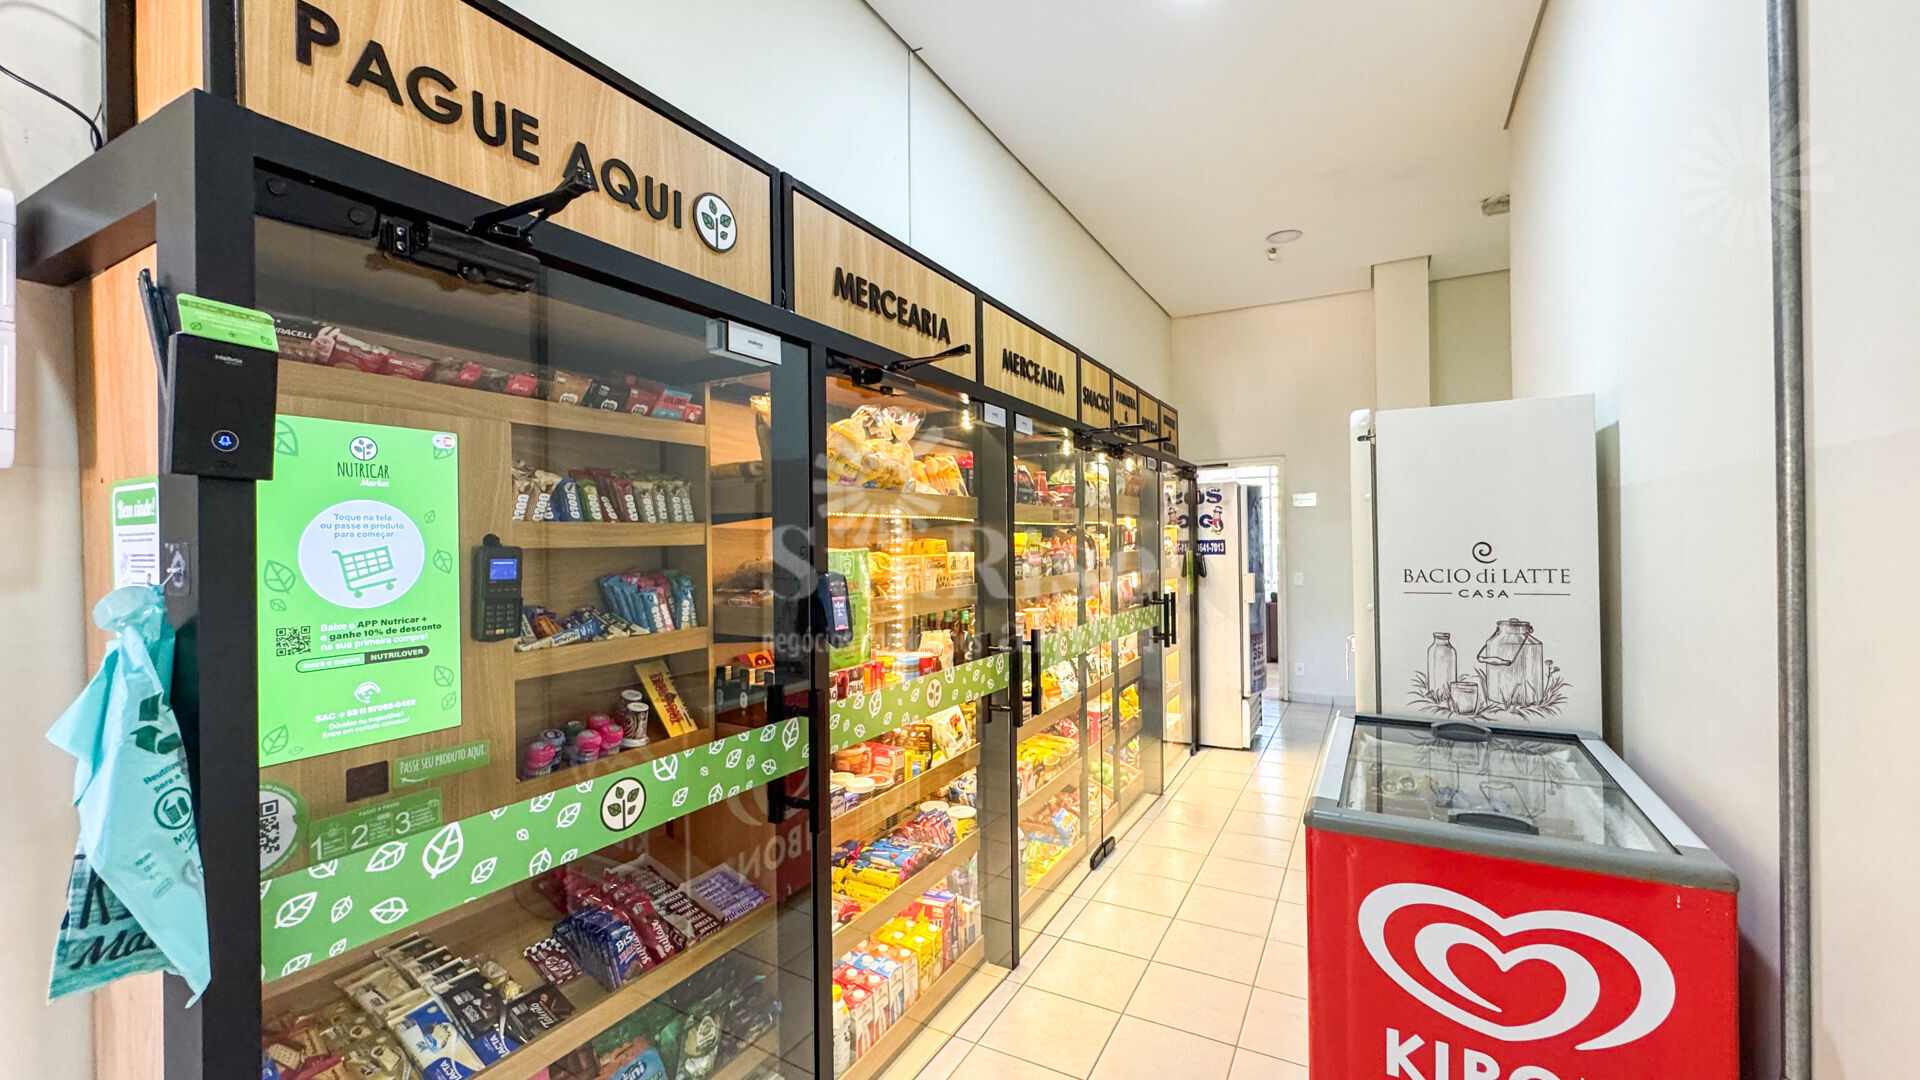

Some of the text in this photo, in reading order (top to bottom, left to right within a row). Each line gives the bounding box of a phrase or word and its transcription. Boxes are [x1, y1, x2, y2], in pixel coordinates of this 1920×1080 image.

[295, 3, 682, 229] PAGUE AQUI
[833, 267, 951, 345] MERCEARIA
[1001, 348, 1065, 396] MERCEARIA
[1083, 386, 1109, 414] SNACKS
[337, 462, 390, 479] NUTRICAR
[360, 478, 390, 487] Market
[333, 513, 361, 521] Toque
[334, 523, 361, 531] passe
[371, 522, 404, 531] produto
[1404, 568, 1571, 584] BACIO di LATTE
[1458, 589, 1509, 598] CASA
[320, 623, 347, 633] Baixe
[357, 620, 379, 629] APP
[380, 617, 419, 627] Nutricar
[329, 630, 361, 642] ganhe
[364, 628, 384, 637] 10%
[386, 627, 398, 635] de
[399, 623, 442, 634] desconto
[320, 644, 333, 652] na
[354, 638, 392, 649] primeira
[370, 648, 424, 661] NUTRILOVER
[400, 760, 420, 775] PASSE
[422, 755, 434, 770] SEU
[435, 749, 466, 766] PRODUTO
[395, 812, 411, 834] 3
[351, 824, 369, 850] 2
[310, 835, 323, 861] 1
[1386, 1027, 1586, 1080] KIB
